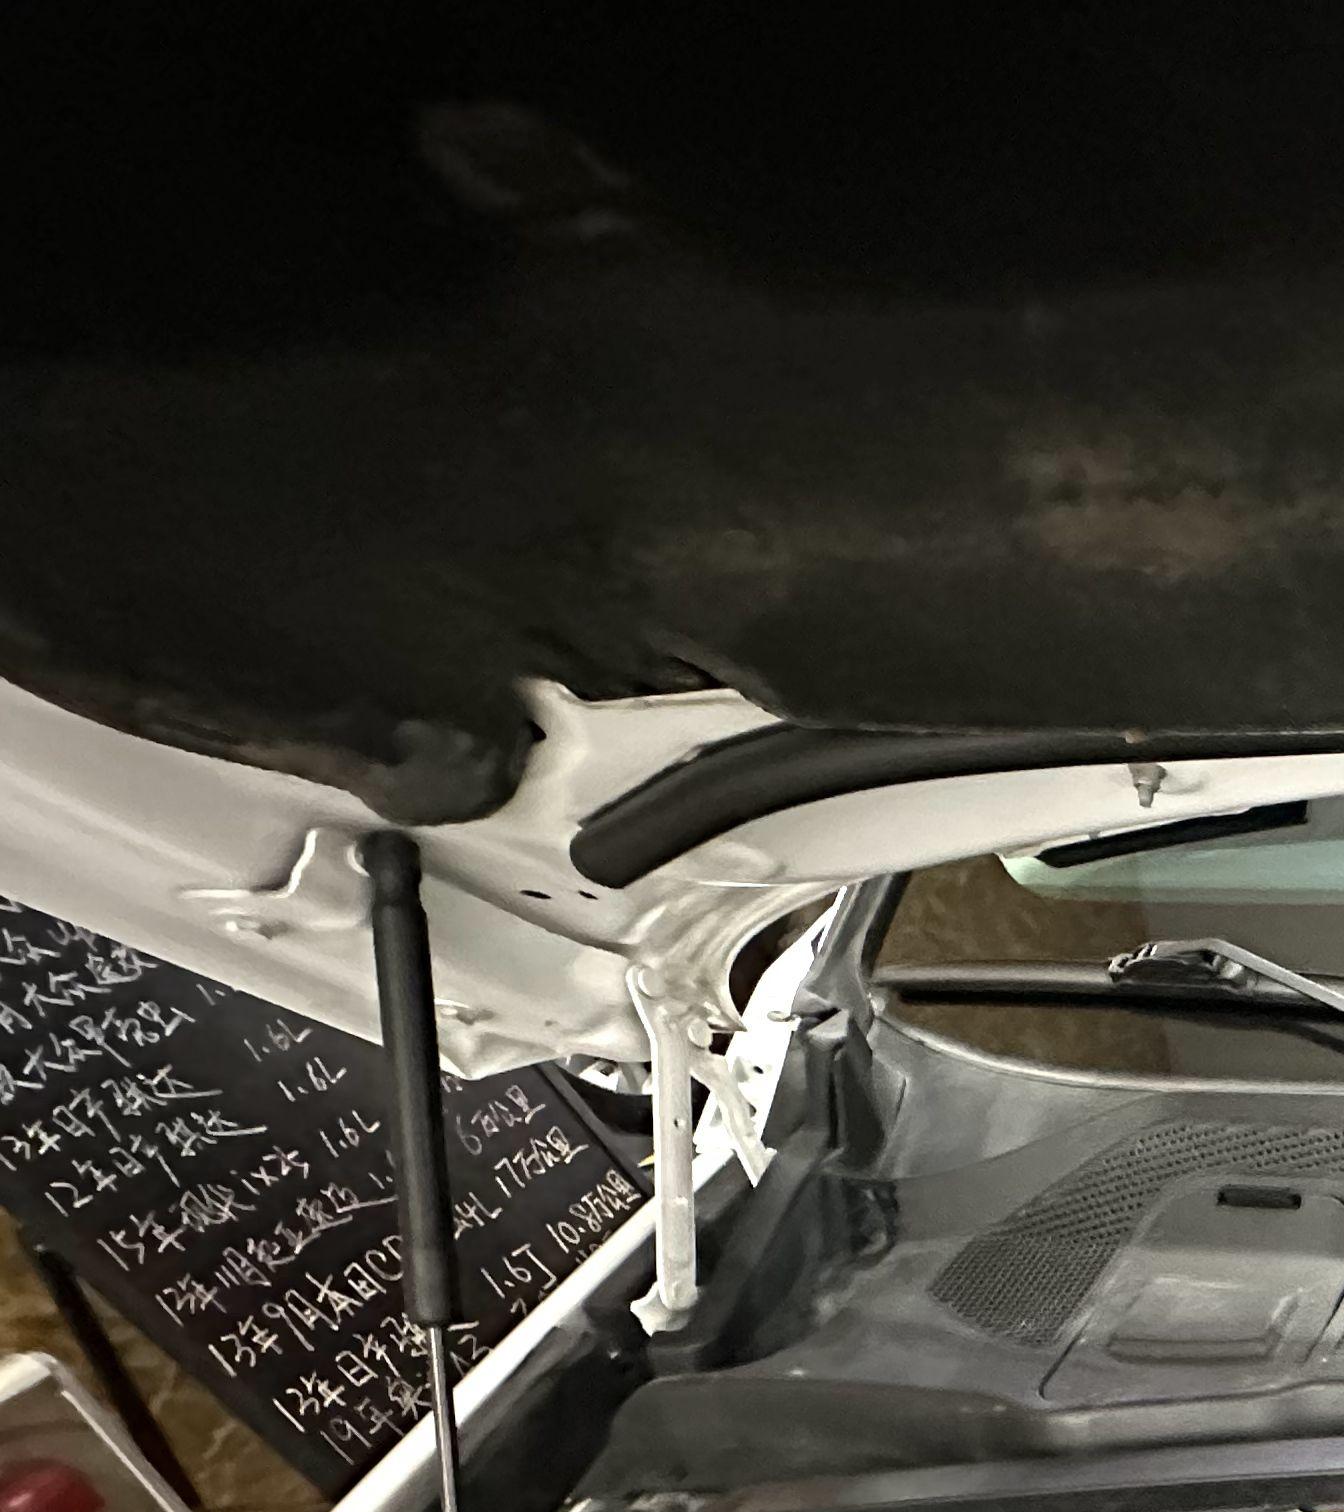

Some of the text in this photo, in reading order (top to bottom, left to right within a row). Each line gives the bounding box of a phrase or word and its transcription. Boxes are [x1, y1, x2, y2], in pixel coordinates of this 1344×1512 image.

[243, 1019, 313, 1061] 1.6L
[278, 1057, 348, 1102] 1.6L
[320, 1110, 381, 1158] 1.6L
